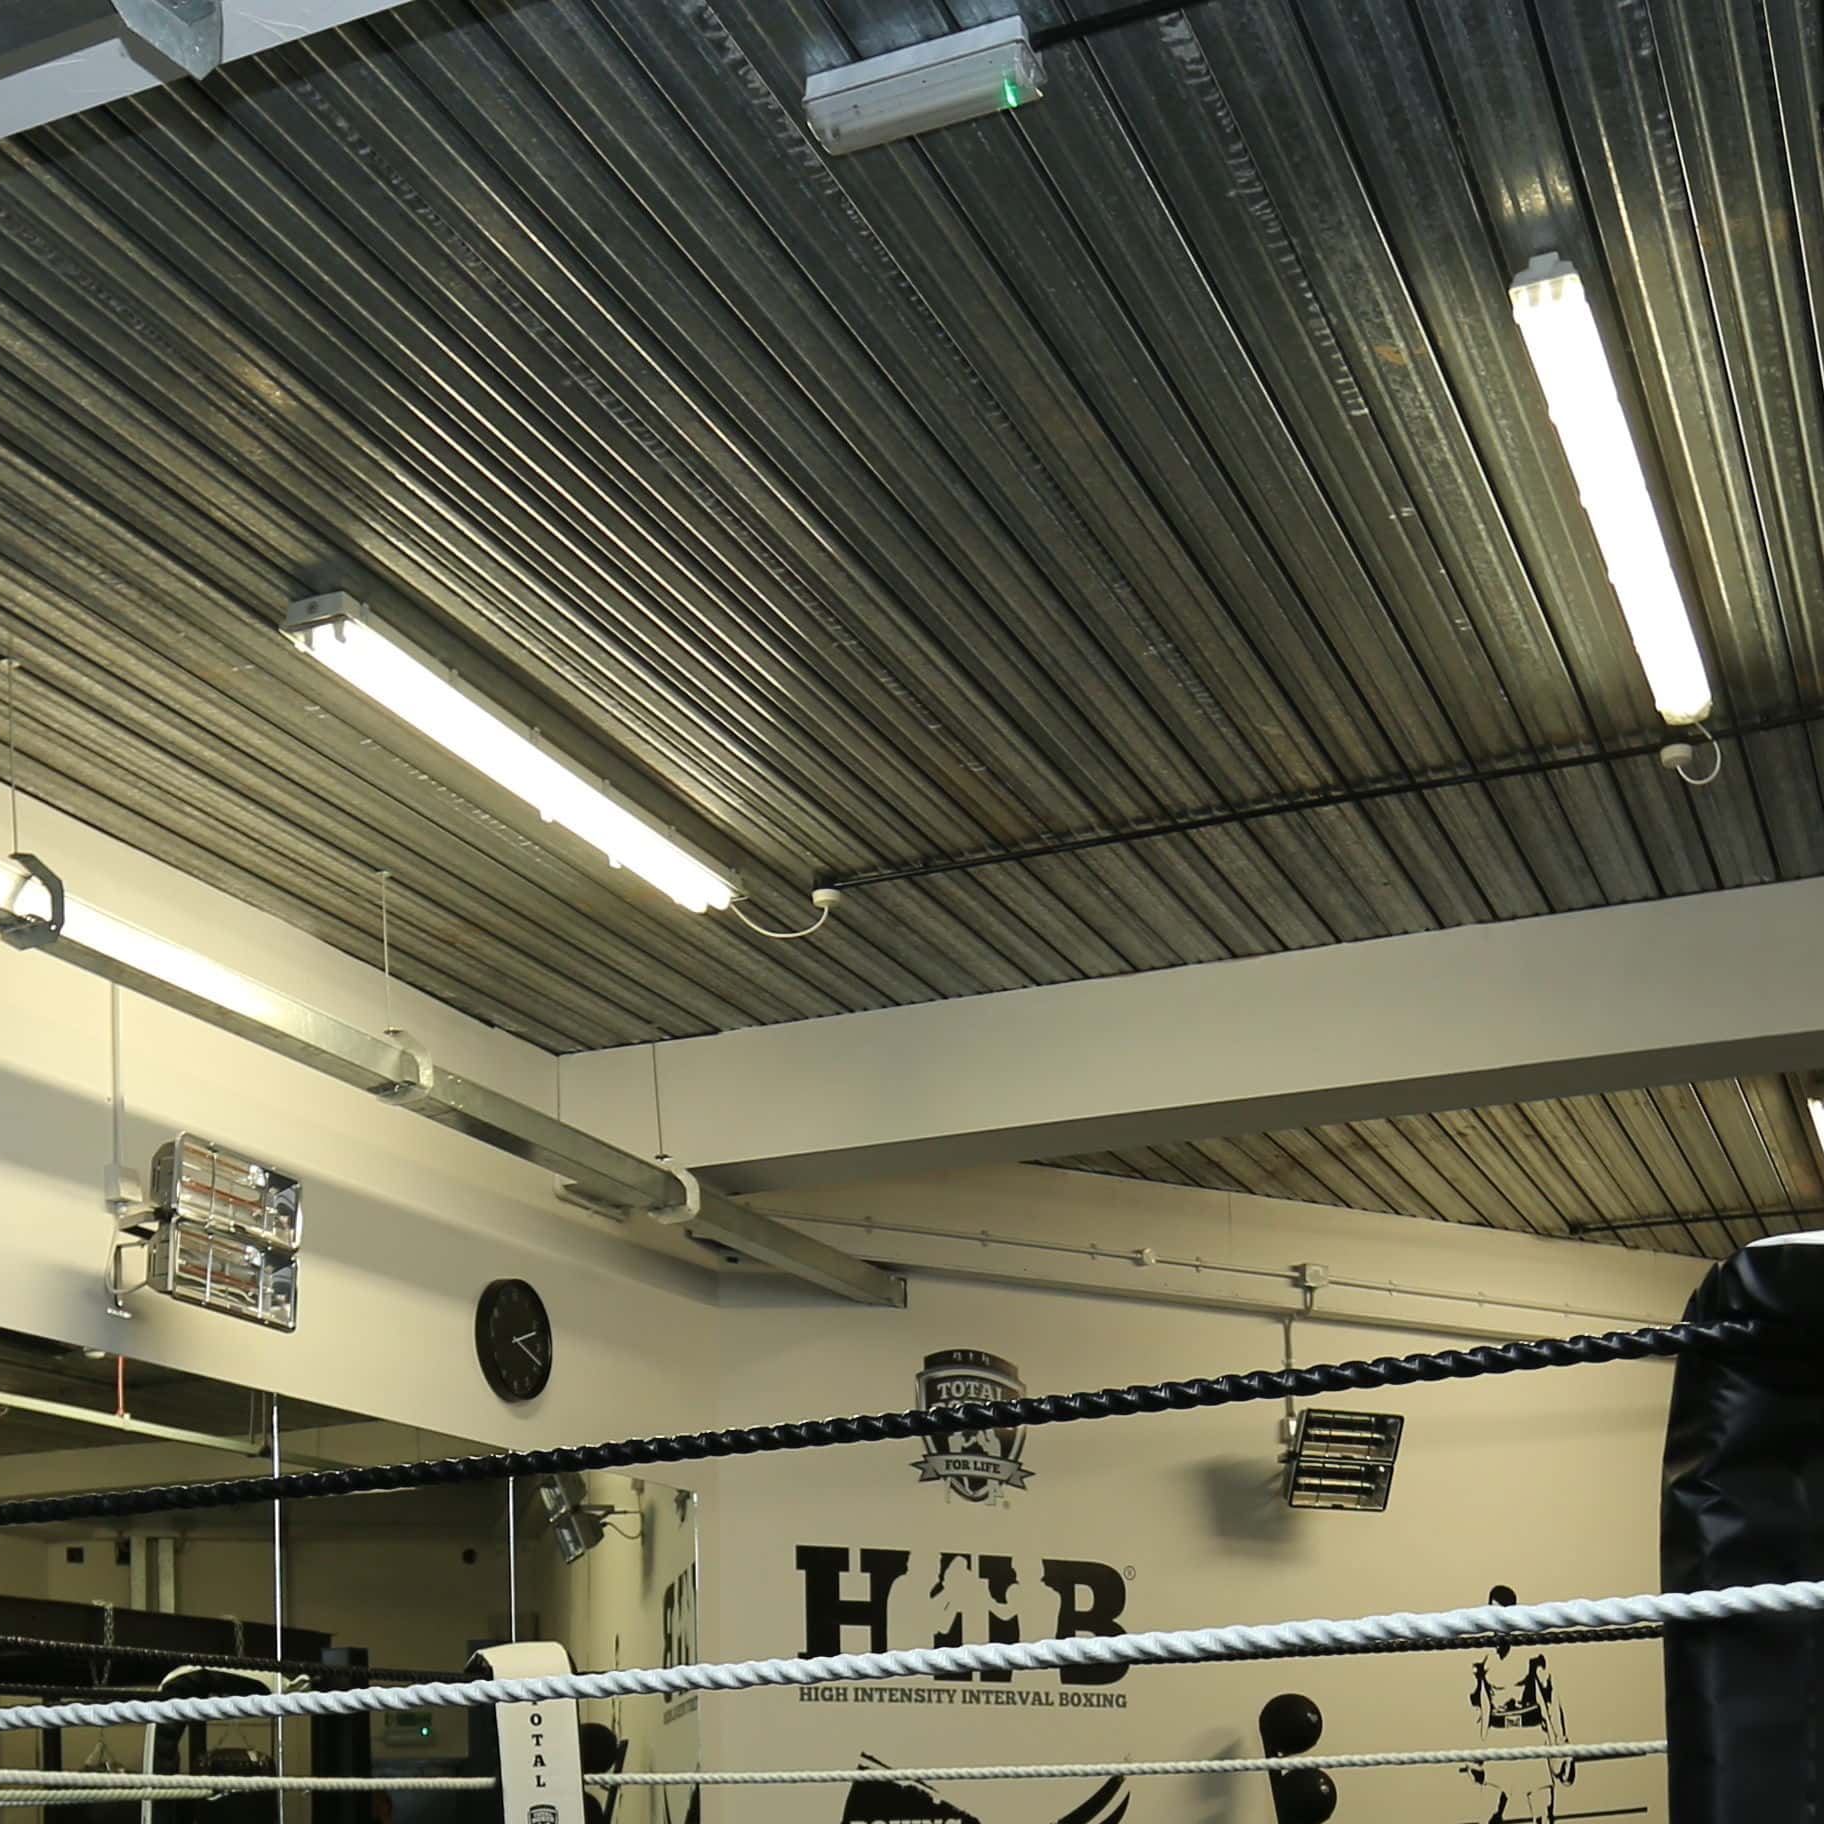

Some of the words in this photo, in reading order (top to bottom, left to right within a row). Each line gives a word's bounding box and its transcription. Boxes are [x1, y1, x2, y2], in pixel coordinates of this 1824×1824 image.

[945, 1459, 970, 1471] FOR
[973, 1460, 1001, 1474] LIFE
[799, 1686, 848, 1703] HIGH
[853, 1687, 957, 1705] INTENSITY
[961, 1689, 1055, 1707] INTERVAL
[1058, 1691, 1129, 1709] BOXING
[529, 1700, 546, 1788] OTAL
